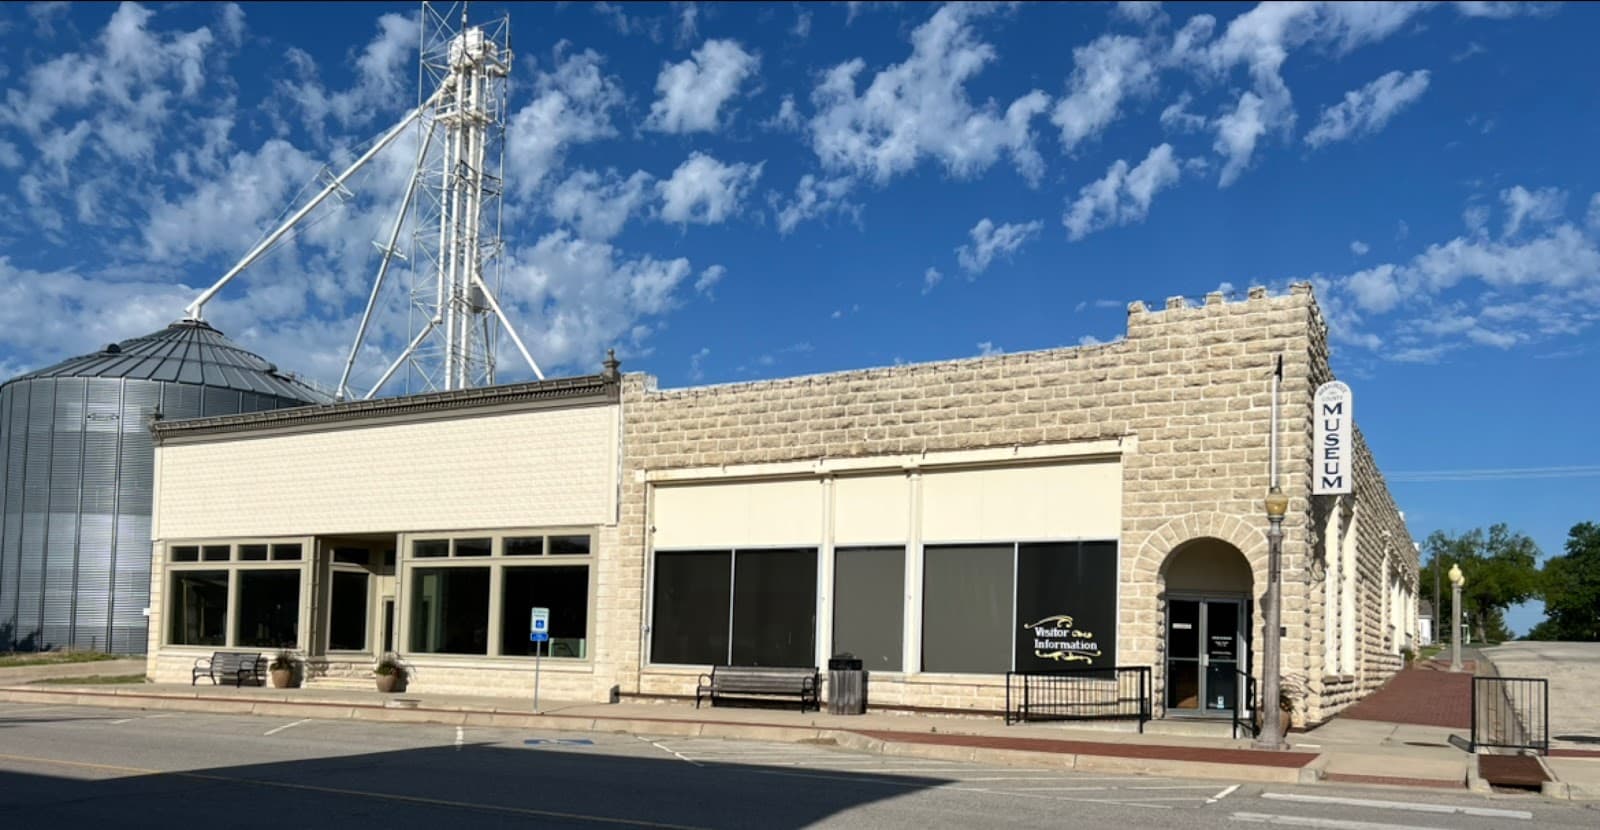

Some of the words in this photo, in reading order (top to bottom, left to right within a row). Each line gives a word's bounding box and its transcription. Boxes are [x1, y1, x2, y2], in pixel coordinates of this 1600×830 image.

[1322, 402, 1342, 488] MUSEUM
[1034, 627, 1069, 637] Visitor
[1034, 639, 1097, 650] Information
